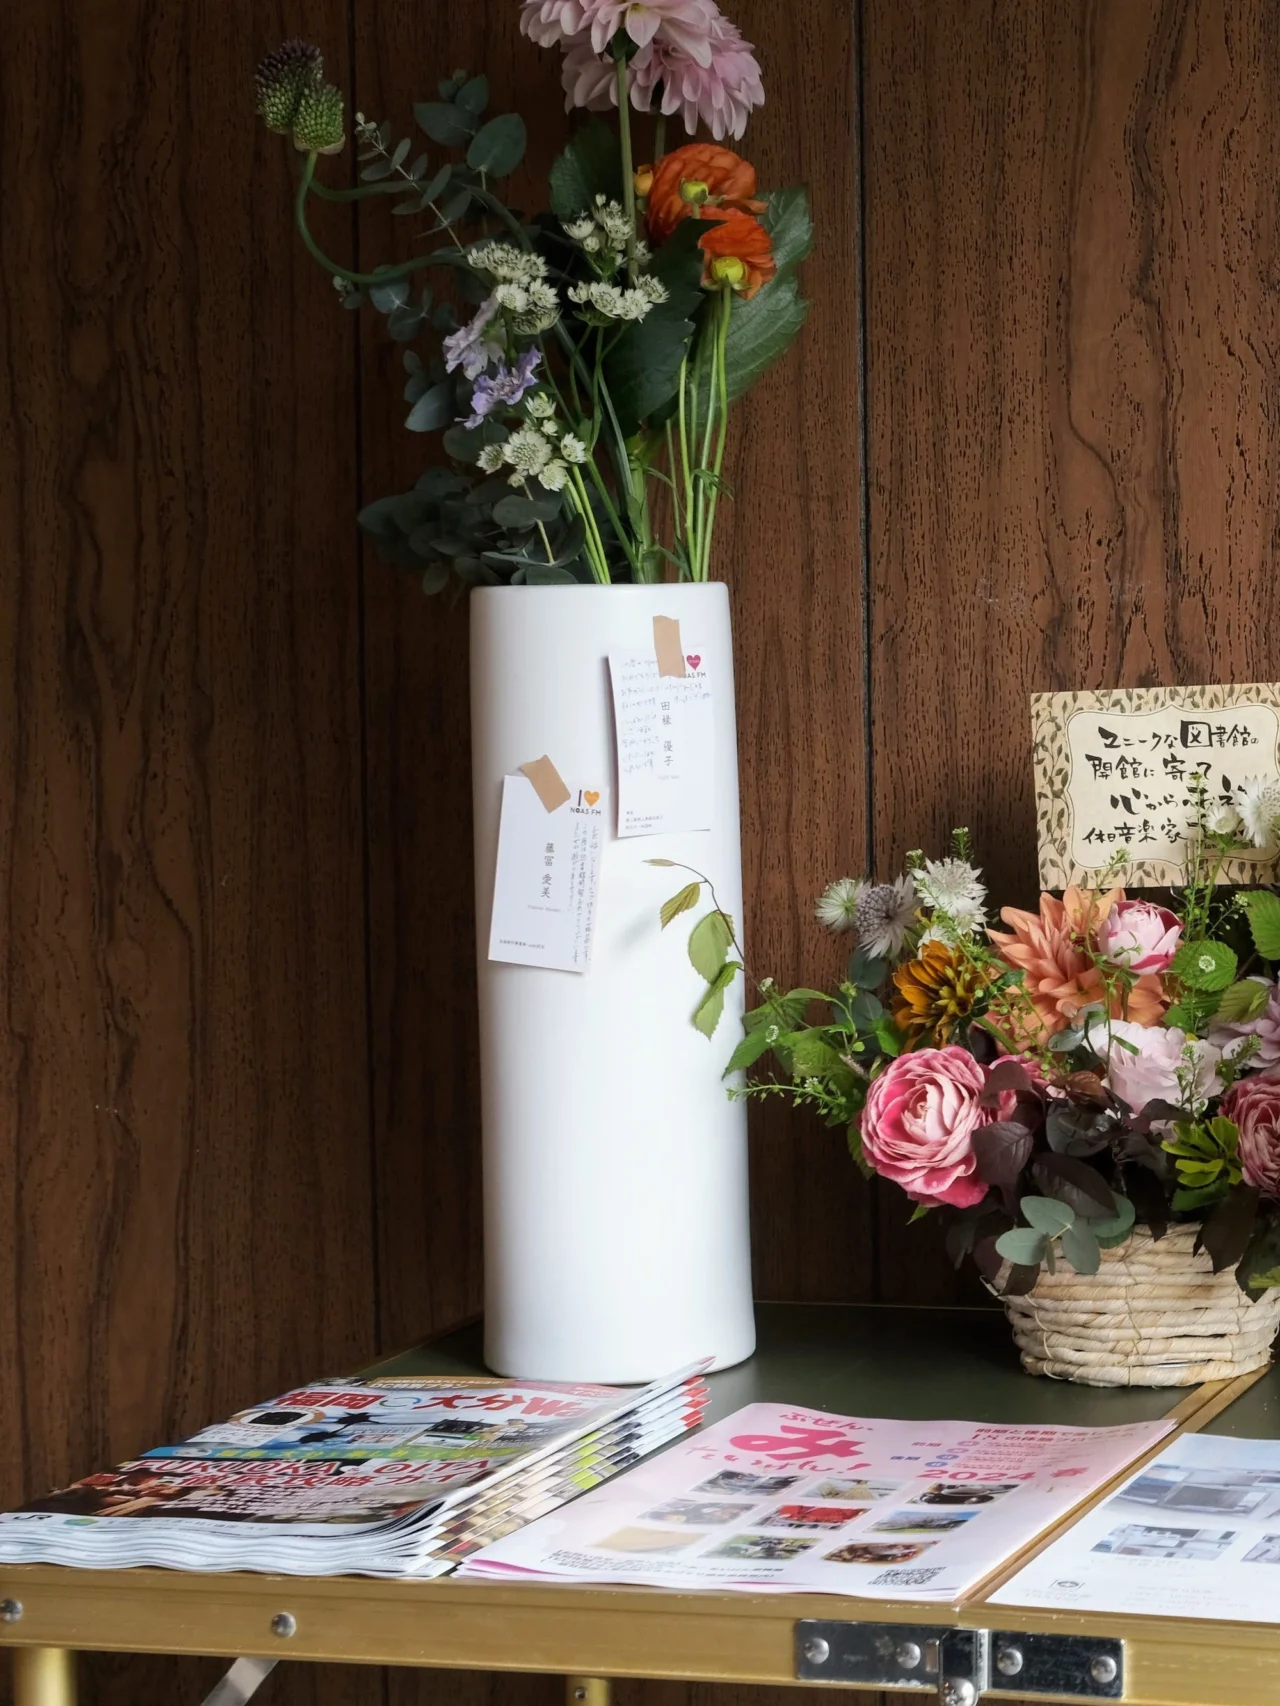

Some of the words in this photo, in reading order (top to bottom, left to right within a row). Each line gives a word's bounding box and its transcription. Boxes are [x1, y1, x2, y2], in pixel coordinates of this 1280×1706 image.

[1098, 720, 1259, 751] ユニークな図書館の
[570, 806, 589, 815] NOAS
[590, 808, 602, 816] FM
[274, 1391, 386, 1410] 福岡
[412, 1393, 527, 1411] 大分
[729, 1424, 866, 1461] み
[127, 1459, 341, 1475] FUKUOKA
[373, 1459, 490, 1475] OITA
[917, 1469, 1037, 1482] 2024
